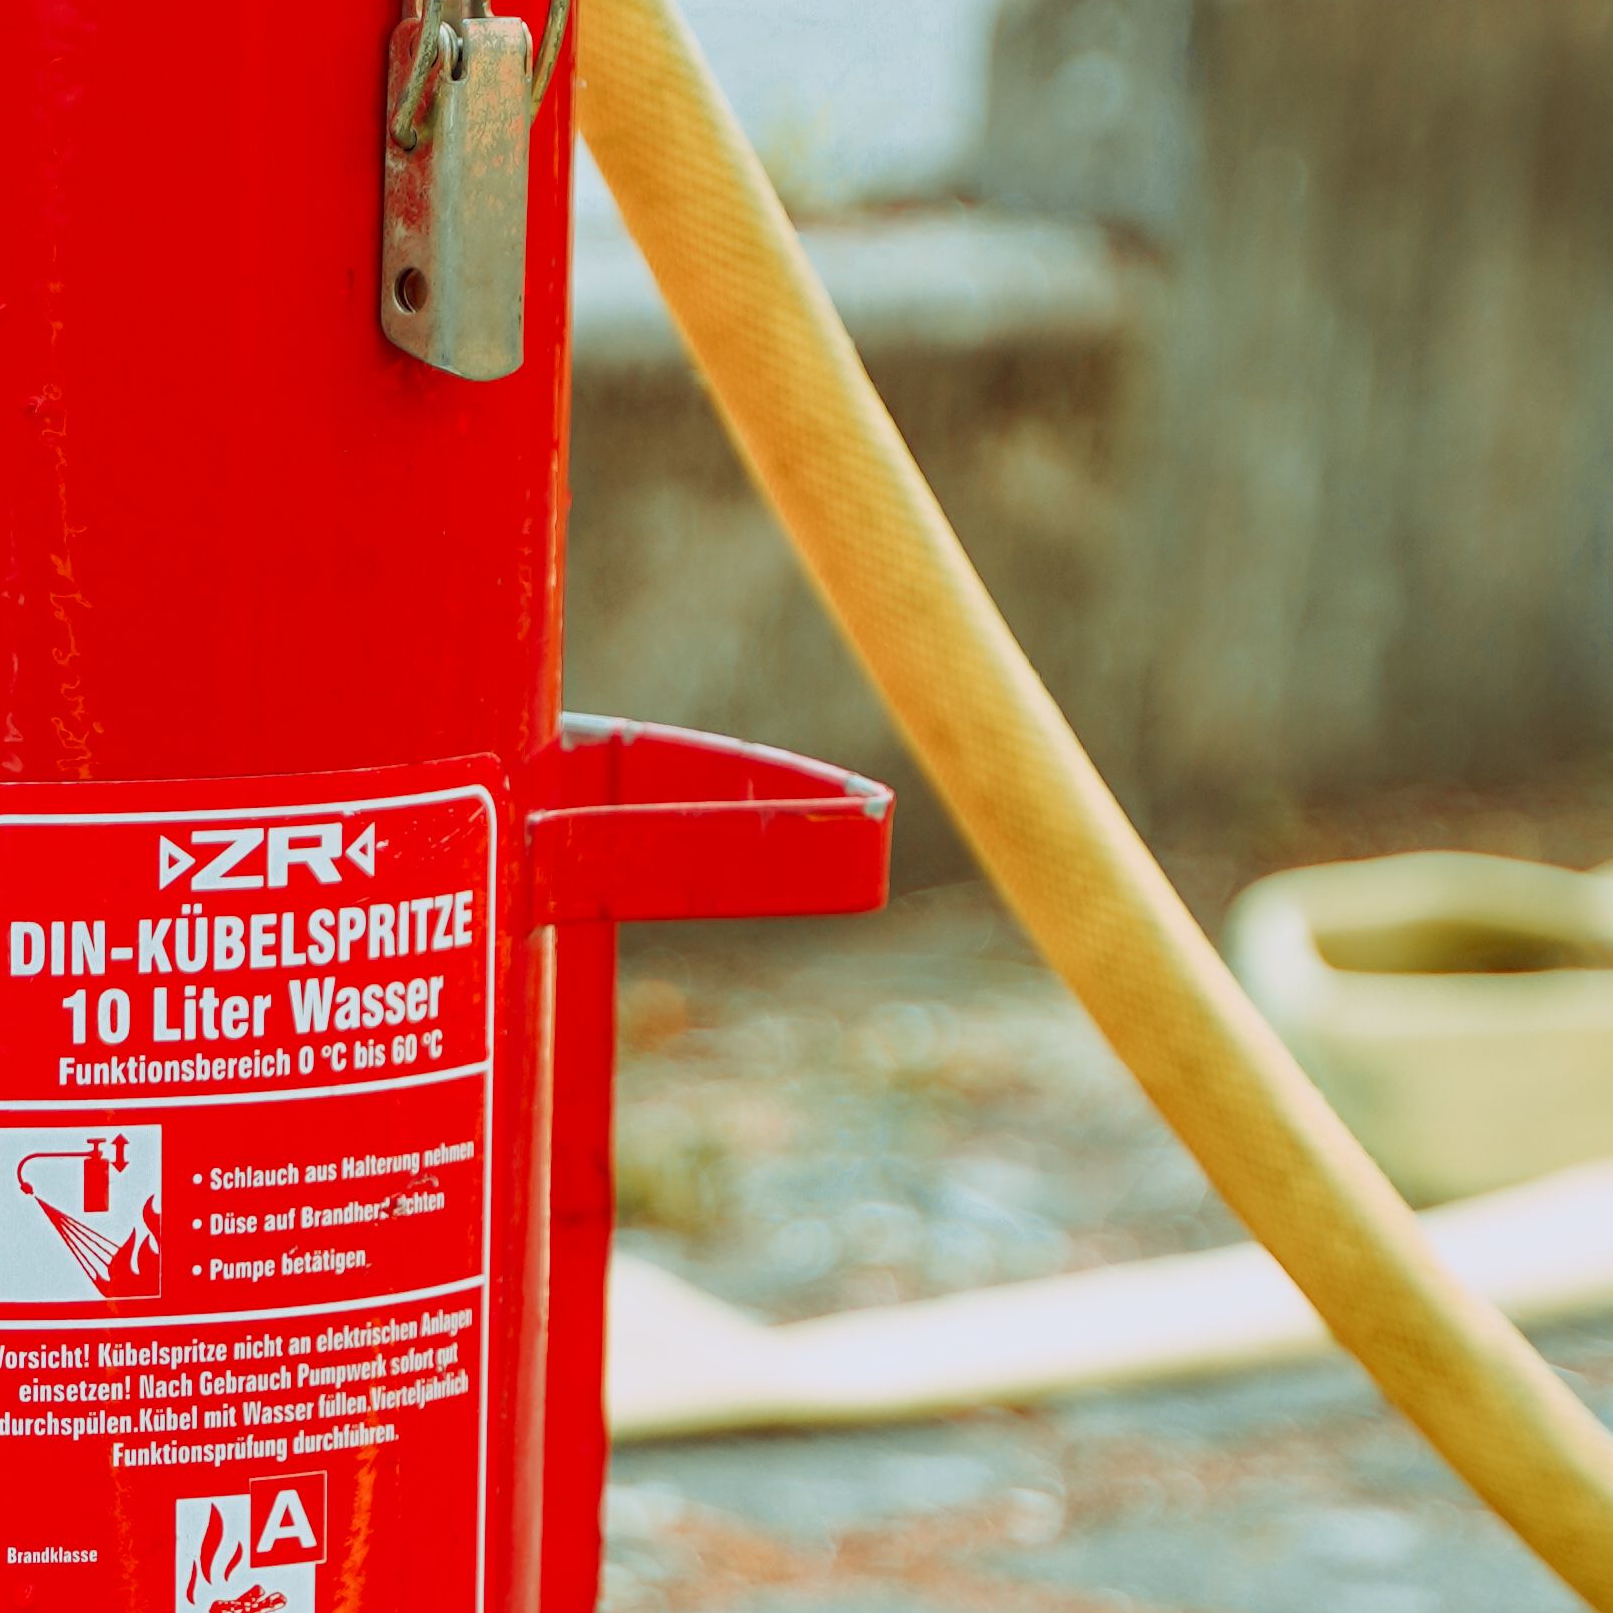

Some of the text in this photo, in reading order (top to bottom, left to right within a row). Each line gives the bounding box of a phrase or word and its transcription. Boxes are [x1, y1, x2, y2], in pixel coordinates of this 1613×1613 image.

[192, 822, 343, 892] ZR
[9, 891, 474, 977] DIN-KÜBELSPRITZE
[62, 975, 445, 1046] 10 Liter Wasser
[58, 1029, 443, 1086] Funktionsbereich 0 °C bis 60 °C
[210, 1141, 475, 1190] Schlauch aus Halterung nehmen
[210, 1213, 258, 1236] Düse
[263, 1208, 296, 1232] auf
[210, 1248, 366, 1283] Pumpe betätigen
[97, 1341, 228, 1369] Kübelspritze
[233, 1338, 284, 1361] nicht
[289, 1337, 311, 1358] an
[317, 1319, 418, 1353] elektrischen
[419, 1308, 473, 1339] Anlagen
[18, 1342, 459, 1405] einsetzen! Nach Gebrauch Pumpwerk sofort gut
[203, 1404, 237, 1429] mit
[242, 1401, 314, 1427] Wasser
[112, 1423, 400, 1468] Funktionsprüfung durchführen.
[256, 1488, 318, 1554] A
[6, 1547, 98, 1566] Brandklasse
